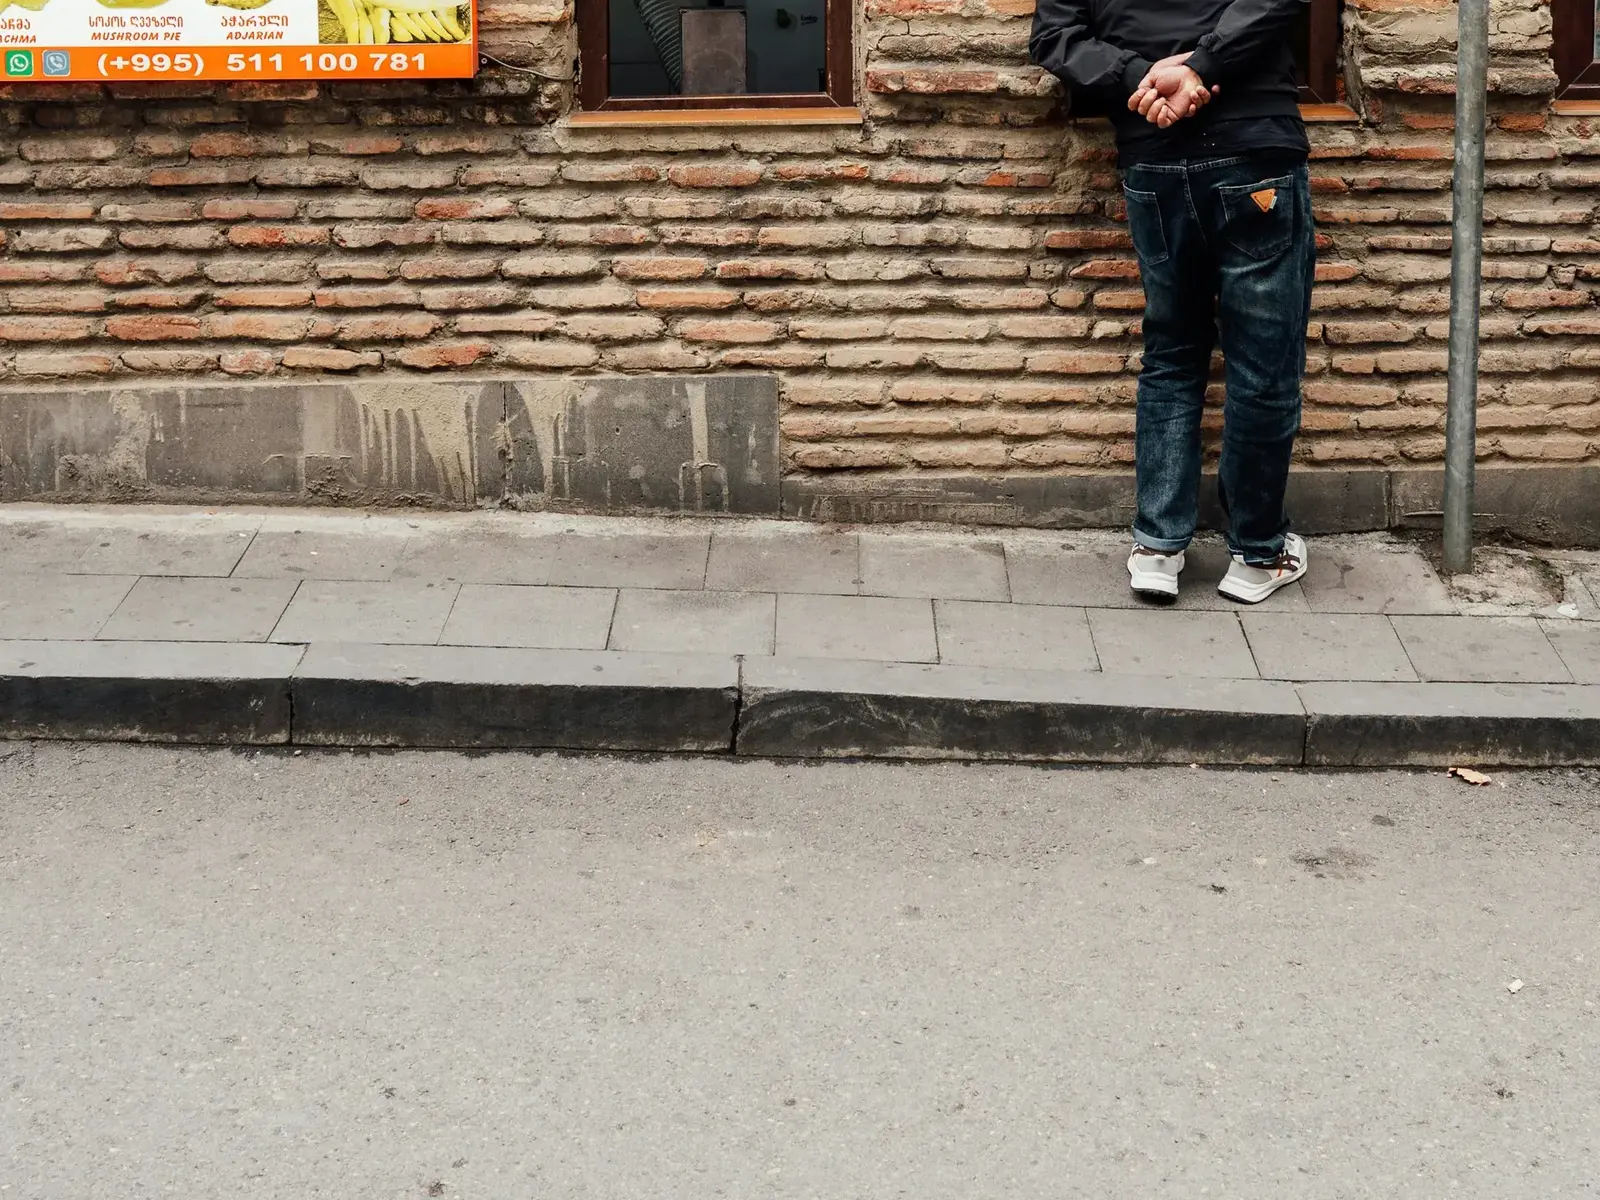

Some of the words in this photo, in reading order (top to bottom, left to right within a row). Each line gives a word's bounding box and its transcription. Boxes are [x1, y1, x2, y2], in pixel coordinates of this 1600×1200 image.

[88, 15, 126, 28] სოკოს
[129, 15, 184, 28] ღვეზელი
[221, 15, 289, 28] აჭარული
[91, 31, 159, 42] MUSHROOM
[163, 31, 182, 41] PIE
[225, 31, 284, 41] ADJARIAN
[97, 53, 204, 76] (+995)
[227, 53, 283, 71] 511
[299, 53, 358, 71] 100
[369, 52, 426, 71] 781
